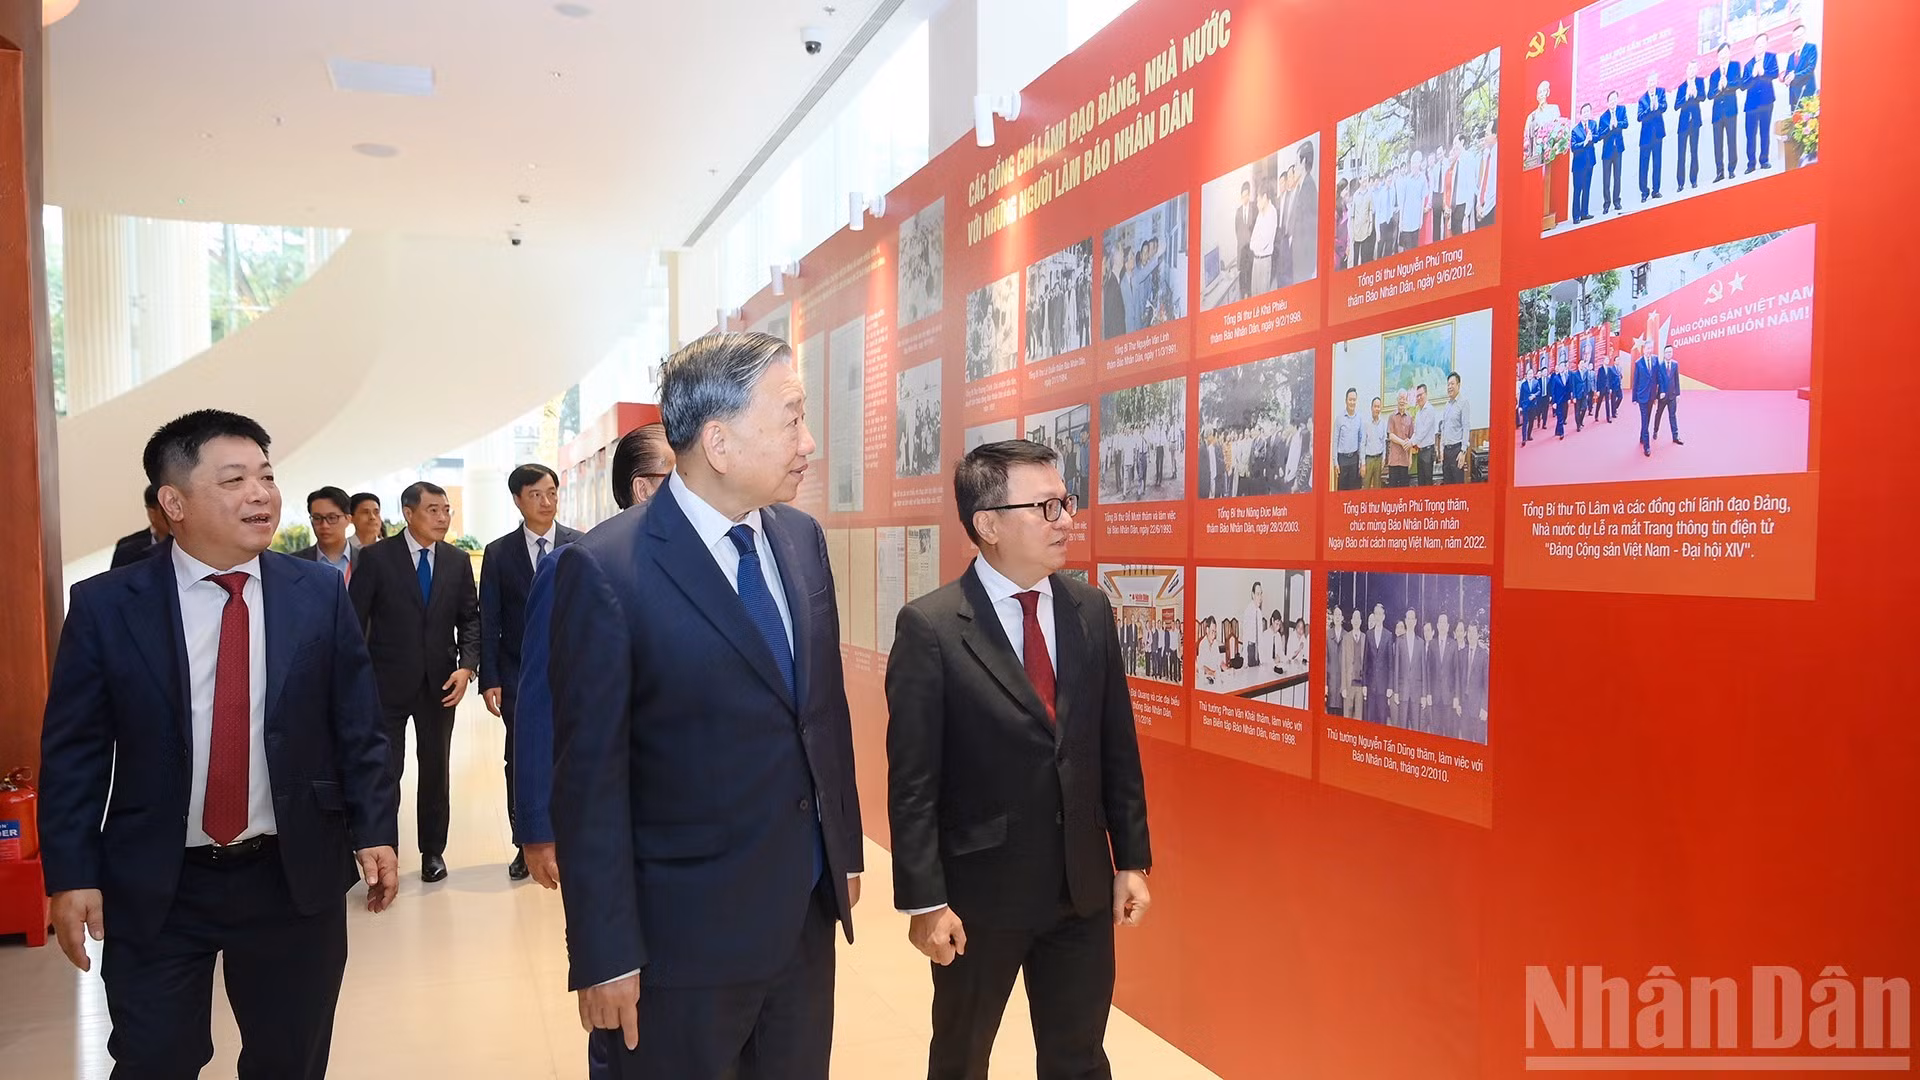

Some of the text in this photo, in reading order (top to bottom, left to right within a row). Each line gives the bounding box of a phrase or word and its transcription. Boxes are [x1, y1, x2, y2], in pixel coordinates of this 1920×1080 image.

[968, 8, 1231, 207] CÁC ĐỒNG CHÍ LÃNH ĐẠO ĐẢNG, NHÀ NƯỚC
[967, 88, 1194, 247] VỚI NHỮNG NGƯỜI LÀM BÁO NHÂN DÂN
[1348, 264, 1474, 307] thăm Báo Nhân Dân, ngày 9/6/2012.
[1358, 249, 1463, 287] Tổng Bí thư Nguyễn Phú Trọng
[1671, 323, 1691, 336] ĐẢNG
[1692, 315, 1718, 332] CỘNG
[1720, 307, 1742, 322] SẢN
[1744, 296, 1775, 314] VIỆT
[1673, 306, 1809, 348] QUANG VINH MUÔN NĂM!
[1344, 498, 1469, 515] Tổng Bí thư Nguyễn Phú Trọng thăm,
[1522, 493, 1791, 519] Tổng Bí thư Tô Lâm và các đồng chí lãnh đạo Đảng,
[1350, 518, 1459, 532] chúc mừng Báo Nhân Dân nhân
[1532, 518, 1774, 538] Nhà nước dự Lễ ra mắt Trang thông tin điện tử
[1328, 536, 1487, 551] Ngày Báo chí cách mạng Việt Nam, năm 2022.
[1545, 542, 1573, 559] "Đảng
[1576, 543, 1600, 560] Cộng
[1602, 543, 1620, 557] sản
[1623, 542, 1642, 559] Việt
[1645, 542, 1670, 556] Nam
[1682, 542, 1700, 560] Đại
[1704, 542, 1722, 560] hội
[1327, 728, 1483, 772] Thủ tướng Nguyễn Tấn Dũng thăm, làm việc với
[1352, 750, 1449, 782] Báo Nhân Dân, tháng 2/2010.
